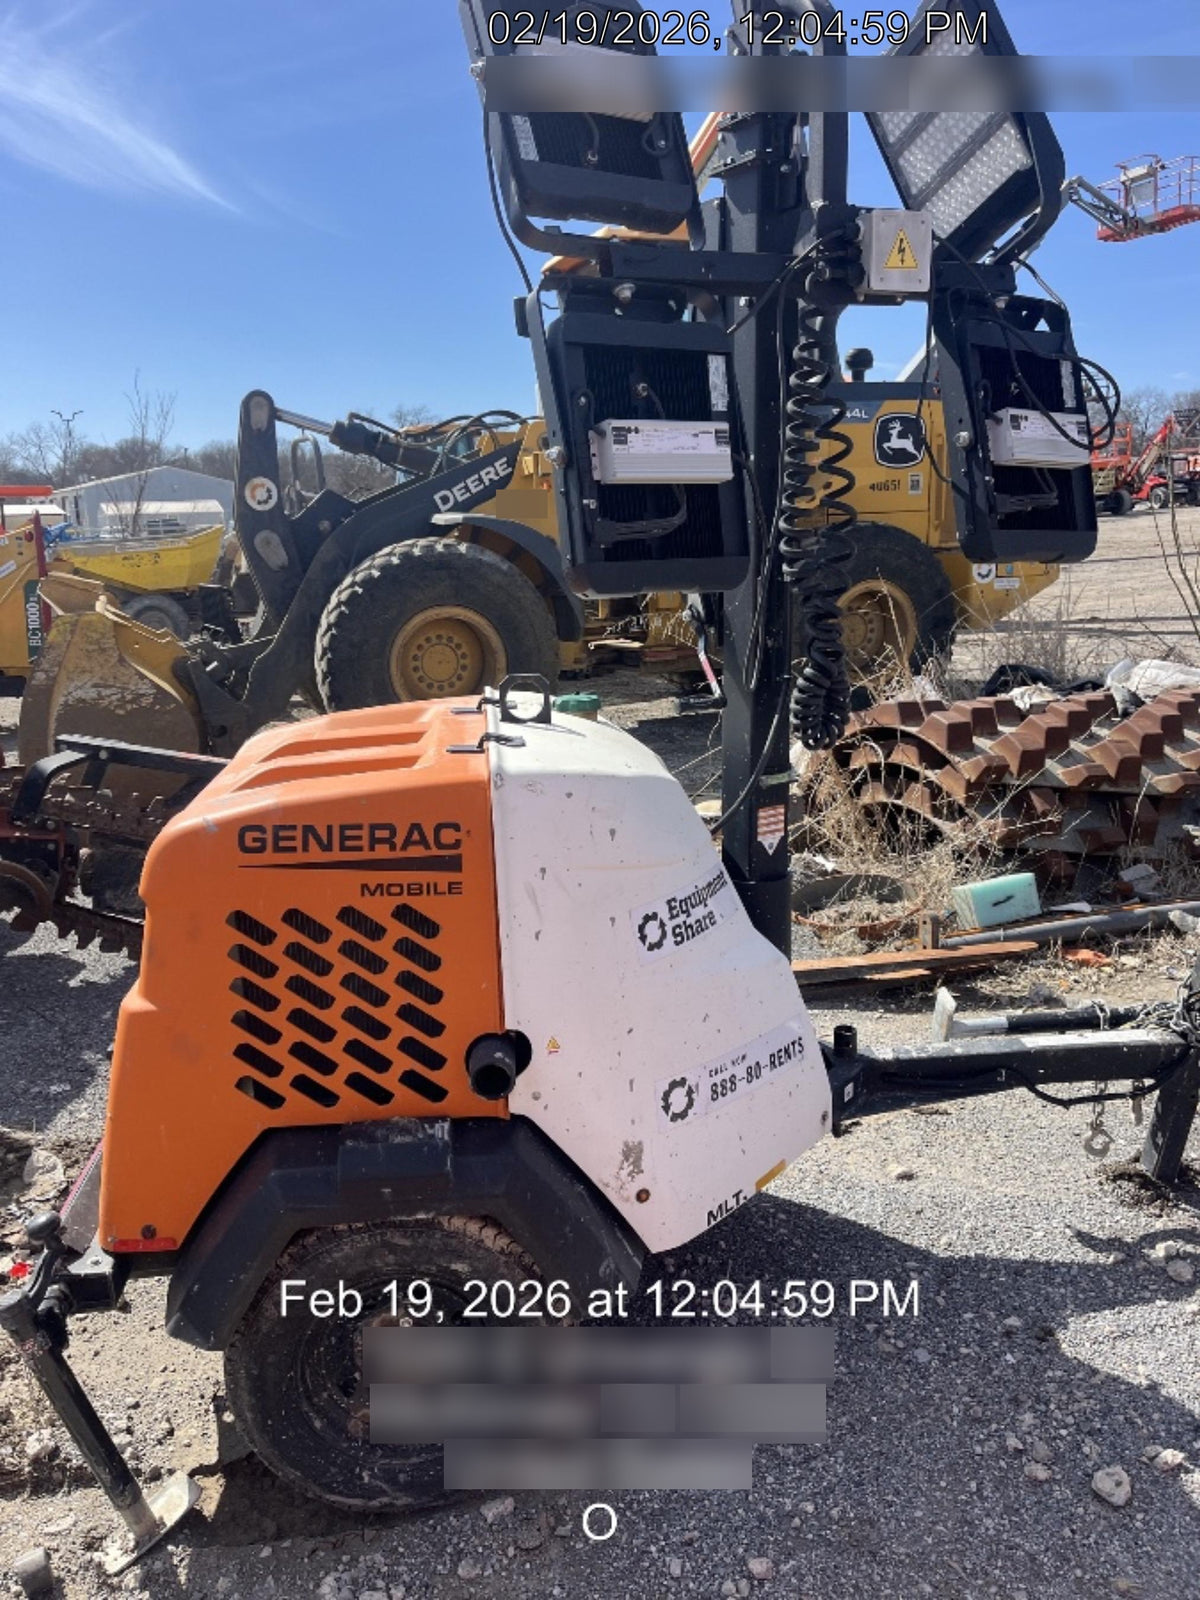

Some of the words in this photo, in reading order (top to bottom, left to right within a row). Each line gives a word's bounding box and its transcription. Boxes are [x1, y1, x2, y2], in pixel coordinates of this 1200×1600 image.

[433, 456, 513, 513] DEERE
[237, 822, 463, 854] GENERAC
[360, 881, 463, 897] MOBILE
[671, 910, 717, 947] Share
[710, 1036, 804, 1102] 888-80-RENTS
